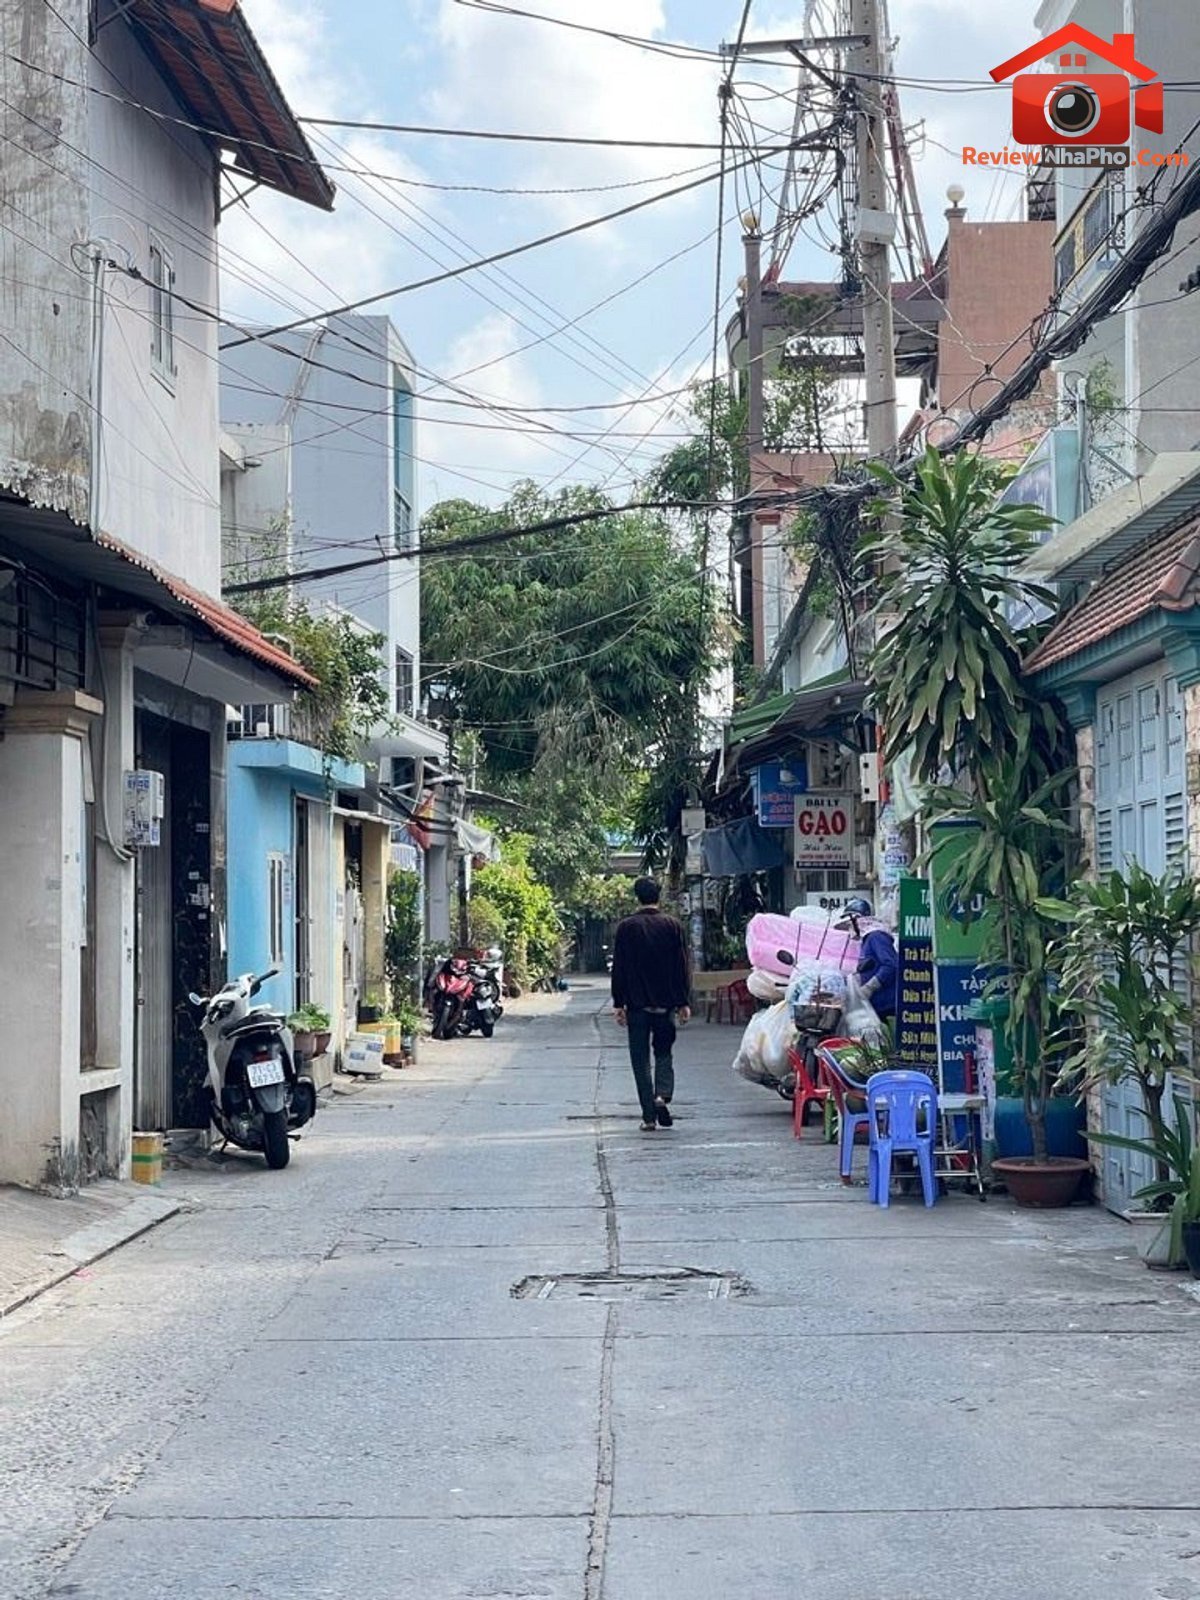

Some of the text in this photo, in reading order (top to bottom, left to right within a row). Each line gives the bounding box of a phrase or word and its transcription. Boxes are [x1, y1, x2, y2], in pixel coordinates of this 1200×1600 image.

[798, 810, 847, 842] GẠO
[903, 968, 930, 982] Chanh
[940, 1004, 967, 1021] KI
[943, 1051, 965, 1061] BIA
